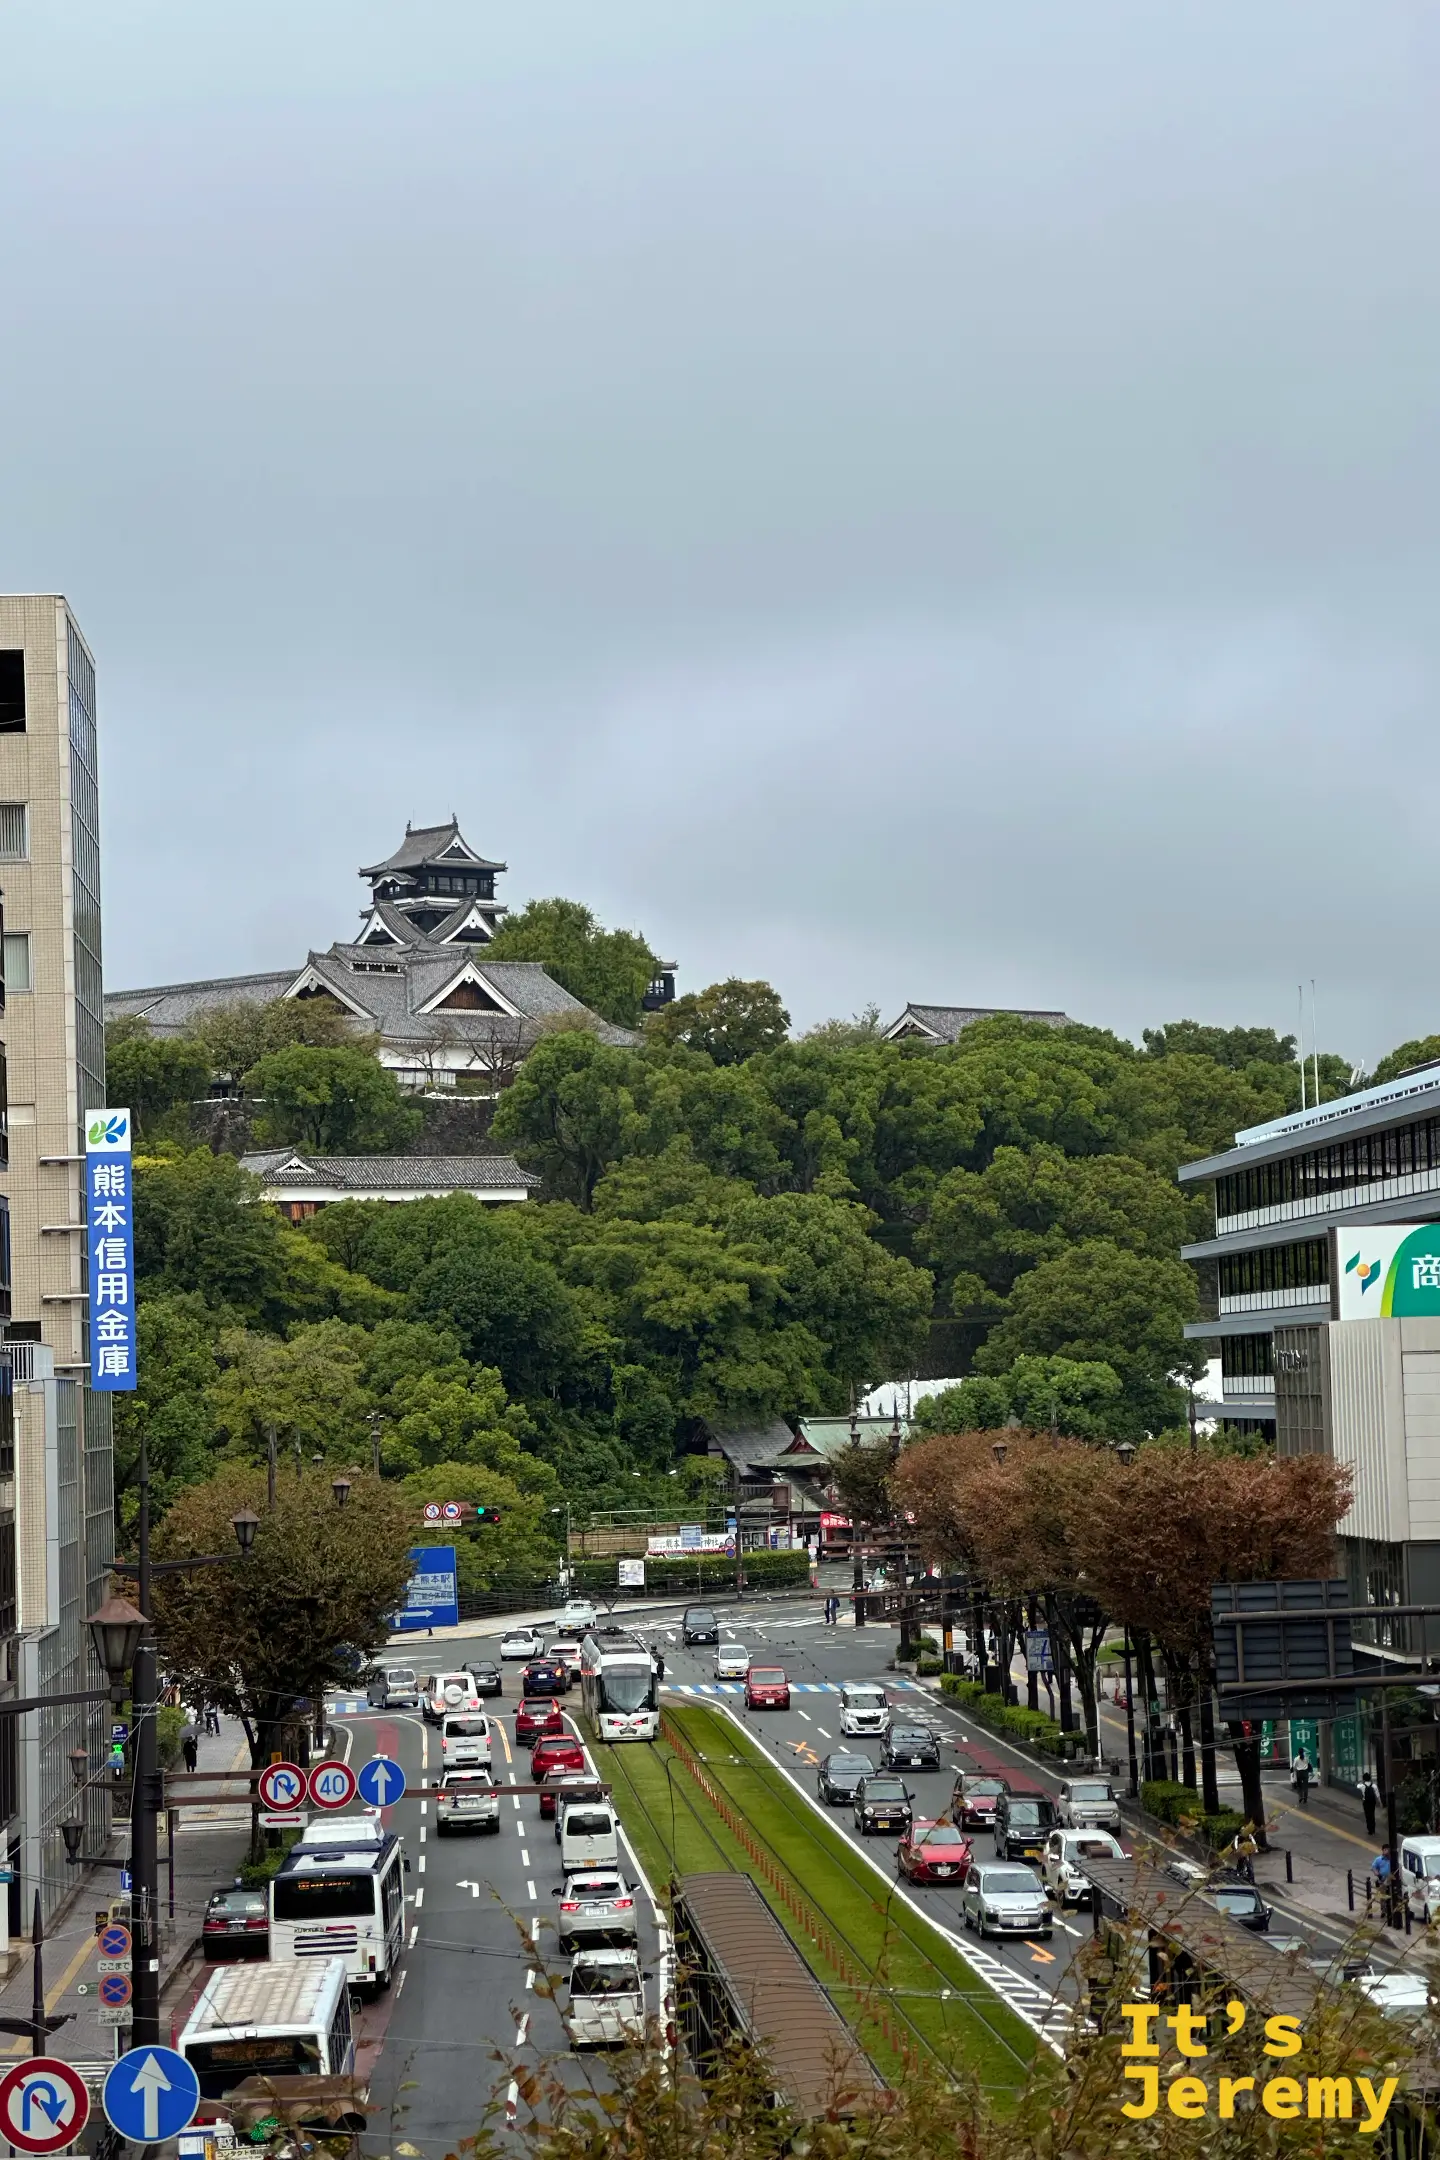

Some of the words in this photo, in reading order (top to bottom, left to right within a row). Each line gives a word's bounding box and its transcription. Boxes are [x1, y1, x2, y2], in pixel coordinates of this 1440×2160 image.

[92, 1164, 130, 1377] 熊本信用金庫
[1411, 1254, 1440, 1289] 商
[113, 1725, 123, 1734] P
[320, 1774, 345, 1796] 40
[100, 1962, 130, 1971] ここまで
